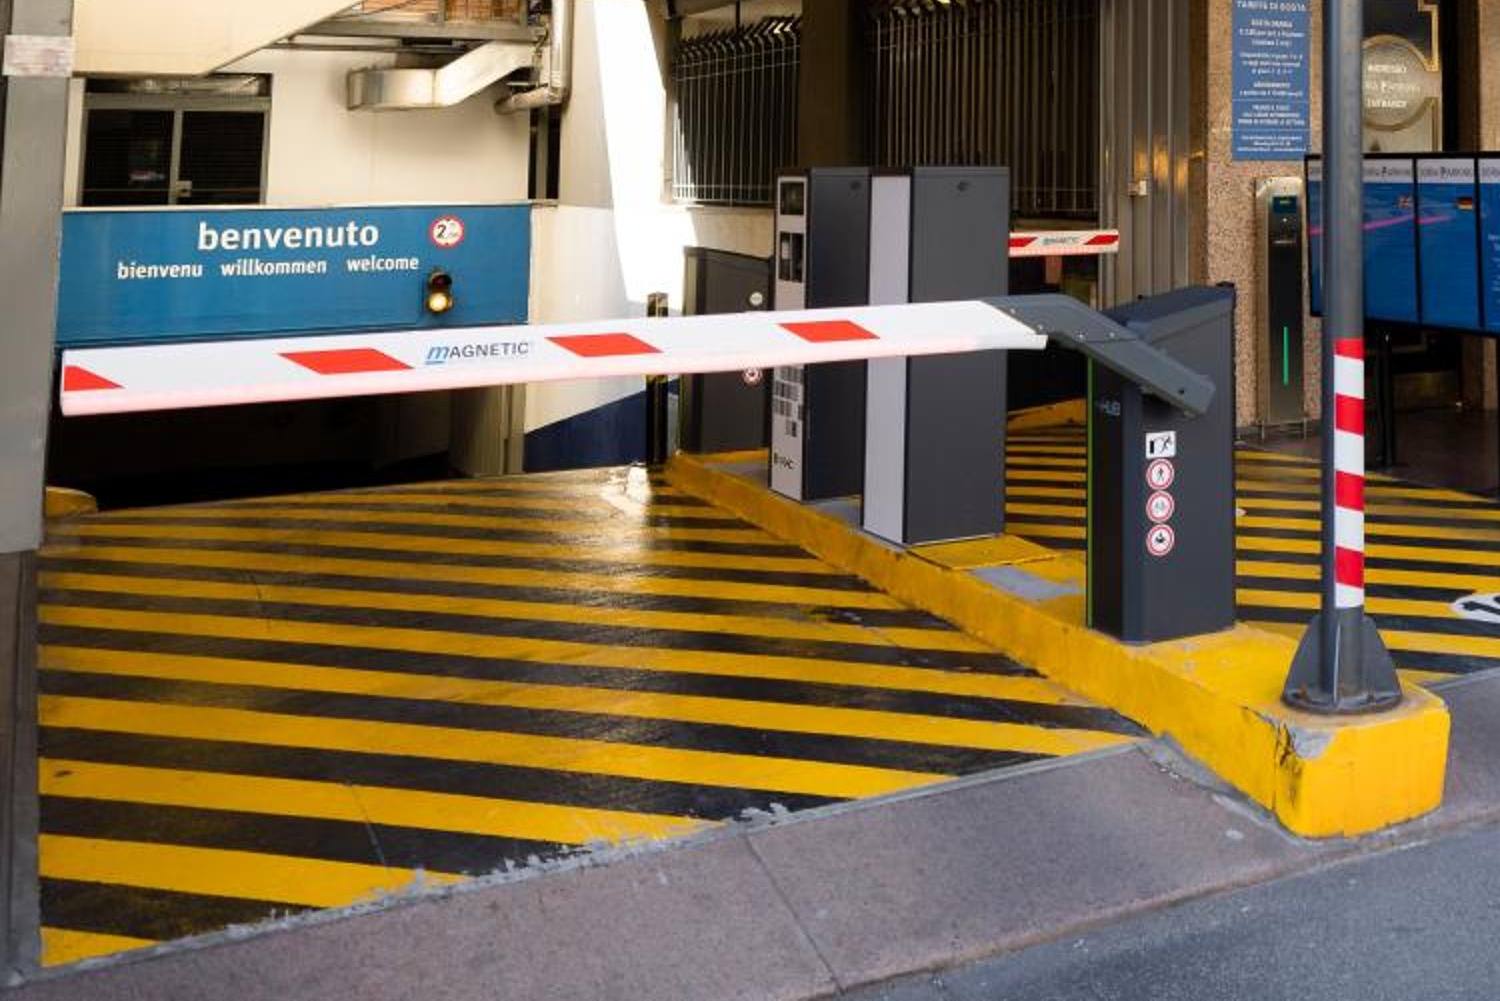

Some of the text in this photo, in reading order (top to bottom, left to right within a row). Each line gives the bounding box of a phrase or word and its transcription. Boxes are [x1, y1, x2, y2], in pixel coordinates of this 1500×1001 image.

[198, 221, 380, 251] benvenuto
[118, 254, 420, 281] bienvenu willkommen welcome
